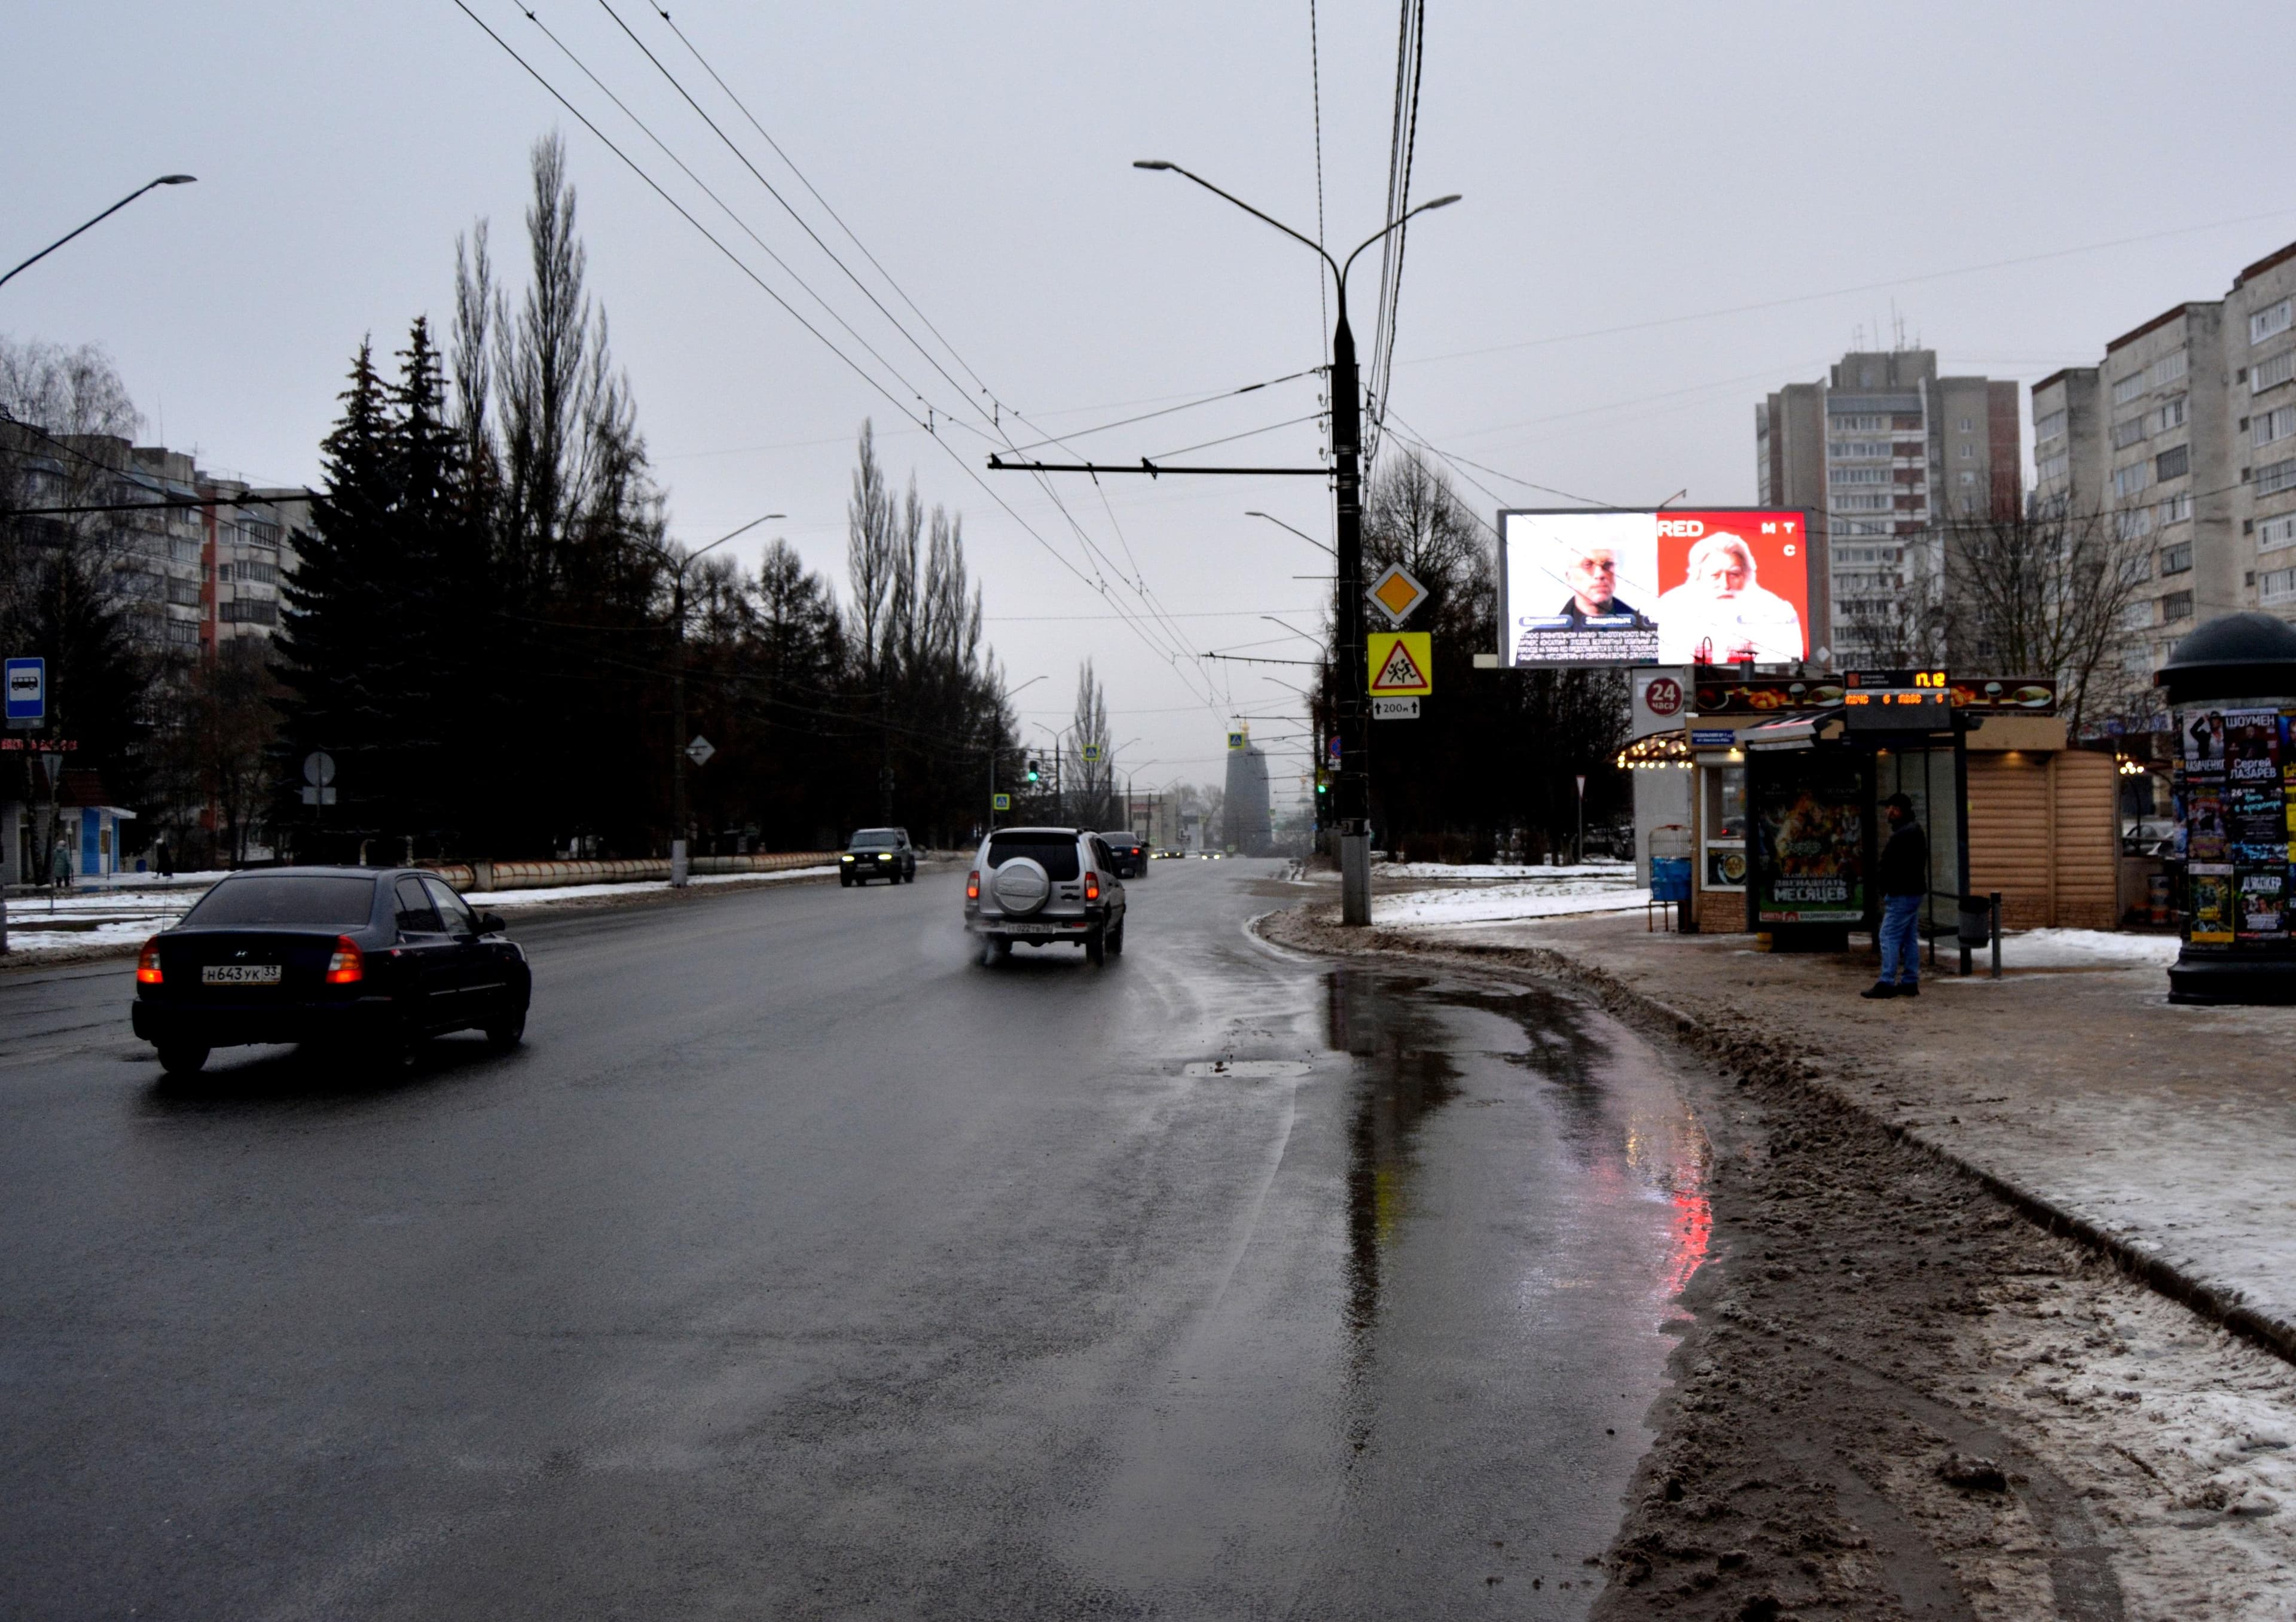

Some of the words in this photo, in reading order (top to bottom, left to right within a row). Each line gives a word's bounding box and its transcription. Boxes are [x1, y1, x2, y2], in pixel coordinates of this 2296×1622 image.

[1658, 520, 1703, 536] RED
[1652, 684, 1675, 701] 24
[1652, 702, 1675, 710] часа
[2225, 715, 2275, 730] ШОУМЕН
[2233, 757, 2271, 770] Сергей
[2230, 766, 2277, 780] ЛАЗАРЕВ
[2240, 876, 2282, 893] ДЖОКЕР
[1773, 887, 1848, 903] МЕСЯЦЕВ
[207, 967, 260, 981] Н643УК
[264, 966, 277, 976] 33
